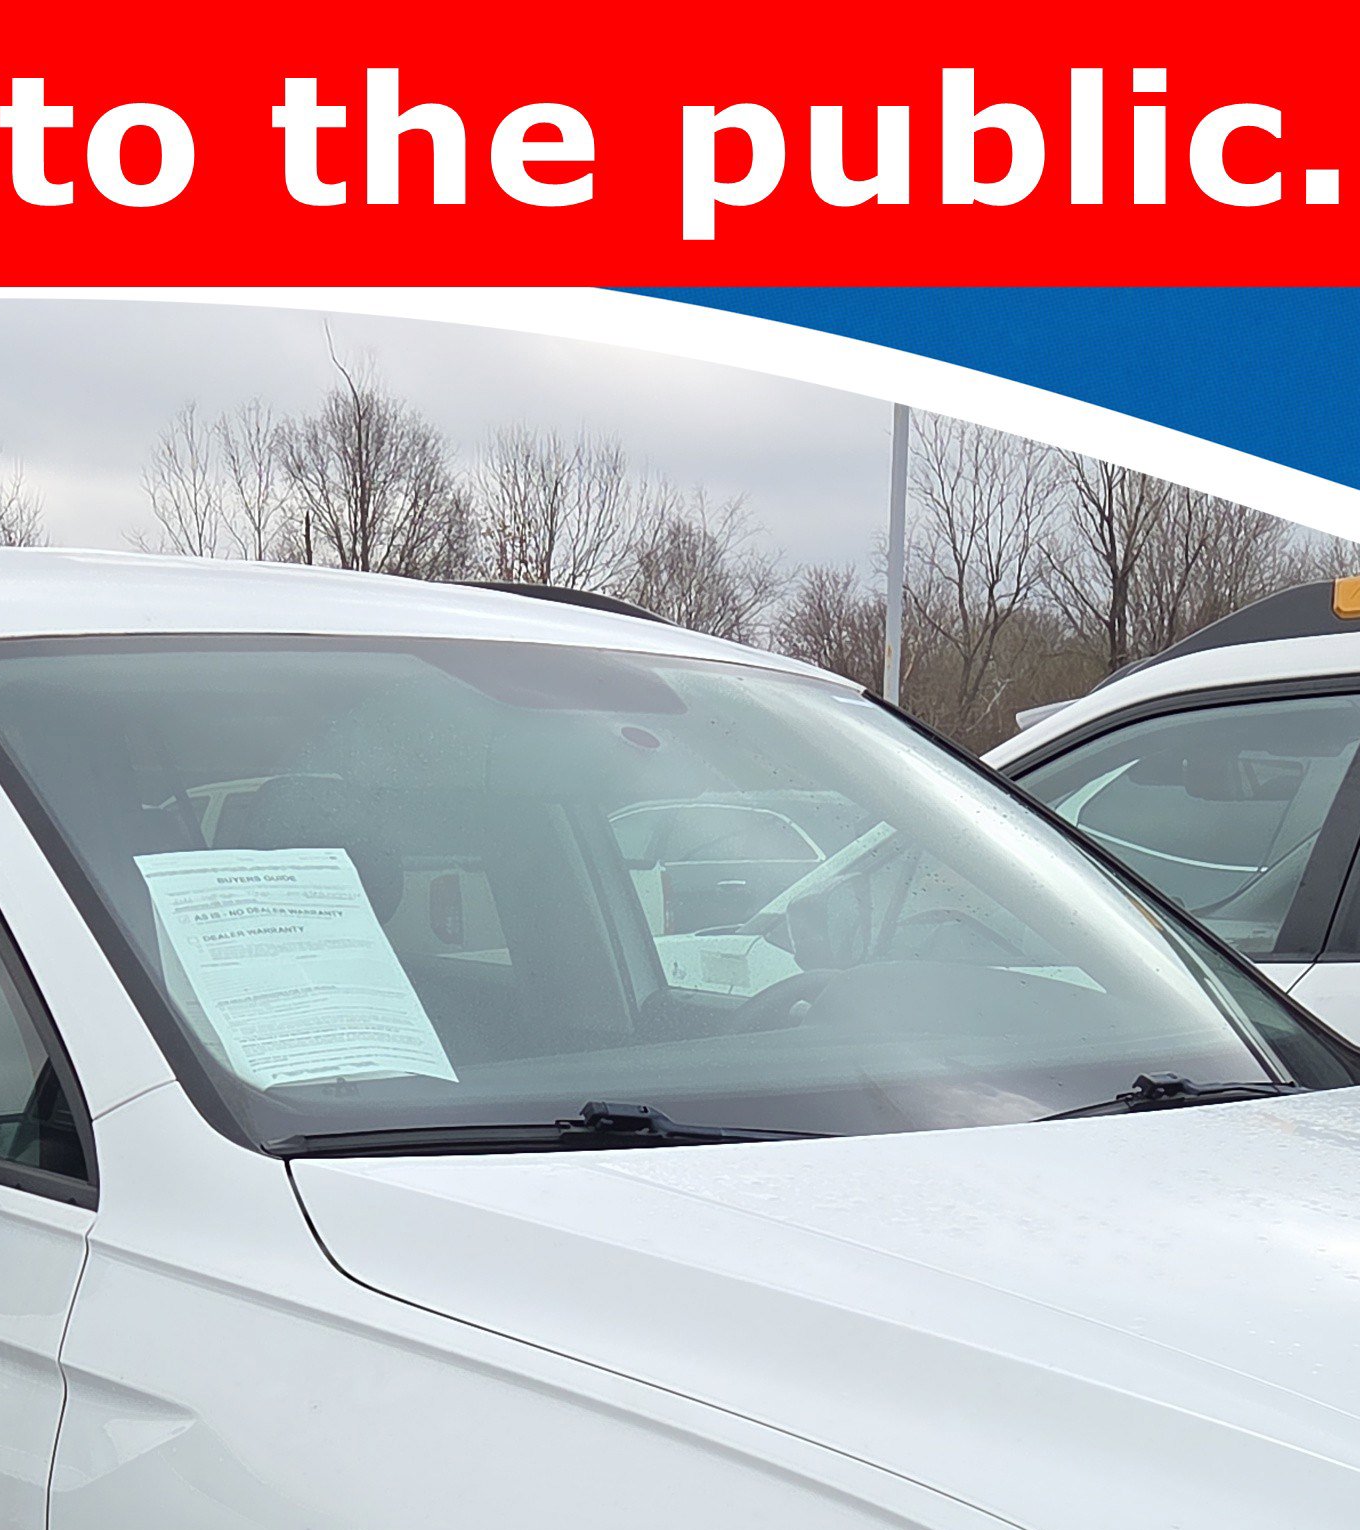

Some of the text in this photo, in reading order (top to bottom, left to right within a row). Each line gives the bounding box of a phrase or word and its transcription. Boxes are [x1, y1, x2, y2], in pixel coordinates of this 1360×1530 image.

[216, 874, 297, 885] BUYERS GUIDE
[194, 913, 208, 922] AS
[210, 912, 221, 920] IS
[228, 908, 245, 917] NO
[246, 907, 286, 916] DEALER
[288, 908, 343, 918] WARRANTY
[202, 926, 305, 942] DEALER WARRANTY
